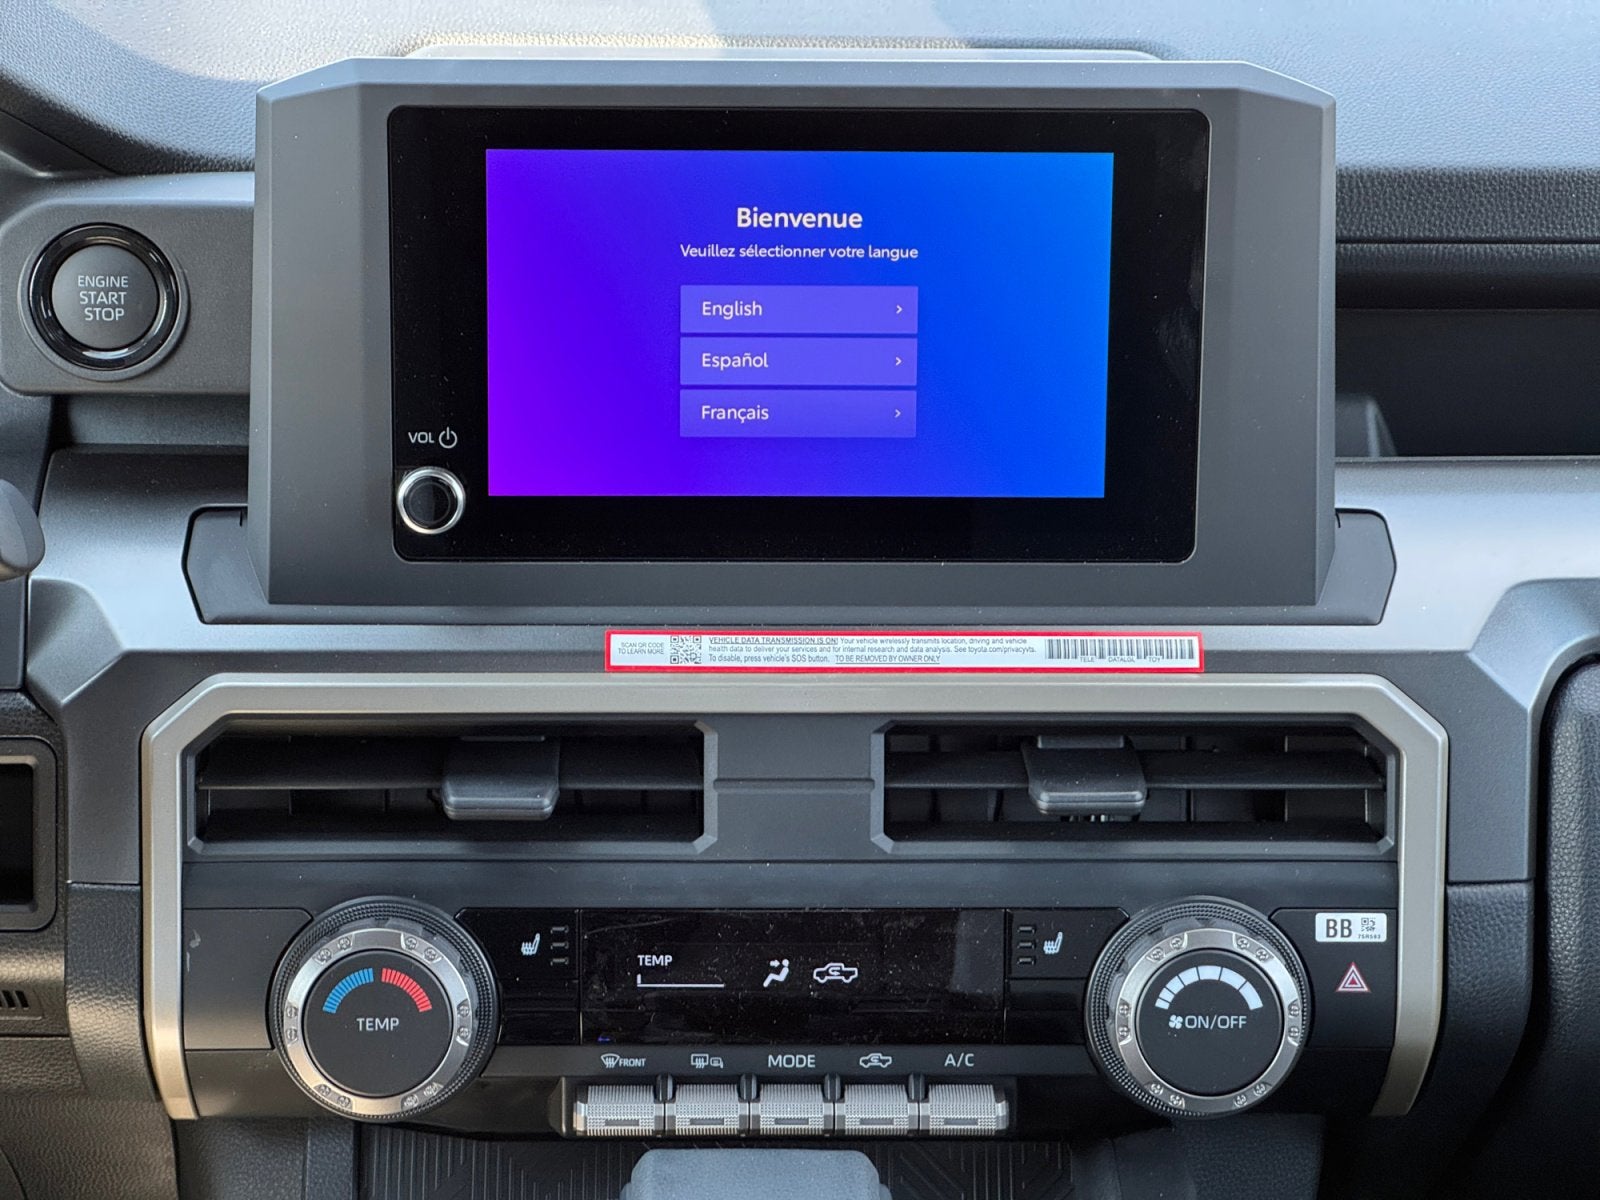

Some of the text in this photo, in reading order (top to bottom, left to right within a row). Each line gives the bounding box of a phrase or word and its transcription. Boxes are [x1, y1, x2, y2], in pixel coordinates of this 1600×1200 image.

[736, 206, 863, 229] Bienvenue
[680, 244, 919, 262] Veuillez sélectionner votre langue
[77, 275, 129, 288] ENGINE
[79, 291, 127, 305] START
[84, 307, 125, 321] STOP
[701, 301, 763, 320] English
[701, 352, 769, 371] Español
[701, 405, 769, 423] Français
[408, 431, 435, 443] VOL
[761, 637, 816, 645] TRANSMISSION
[816, 637, 824, 645] IS
[879, 637, 910, 645] wirelessly
[941, 637, 967, 645] location,
[969, 638, 990, 646] driving
[954, 645, 967, 653] See
[709, 654, 717, 662] To
[718, 654, 742, 663] disable,
[763, 654, 790, 662] vehicle's
[1326, 919, 1352, 938] BB
[637, 955, 673, 967] TEMP
[356, 1017, 400, 1032] TEMP
[1184, 1015, 1248, 1030] ON/OFF
[619, 1057, 646, 1068] FRONT
[767, 1054, 816, 1069] MODE
[944, 1053, 975, 1068] A/C
